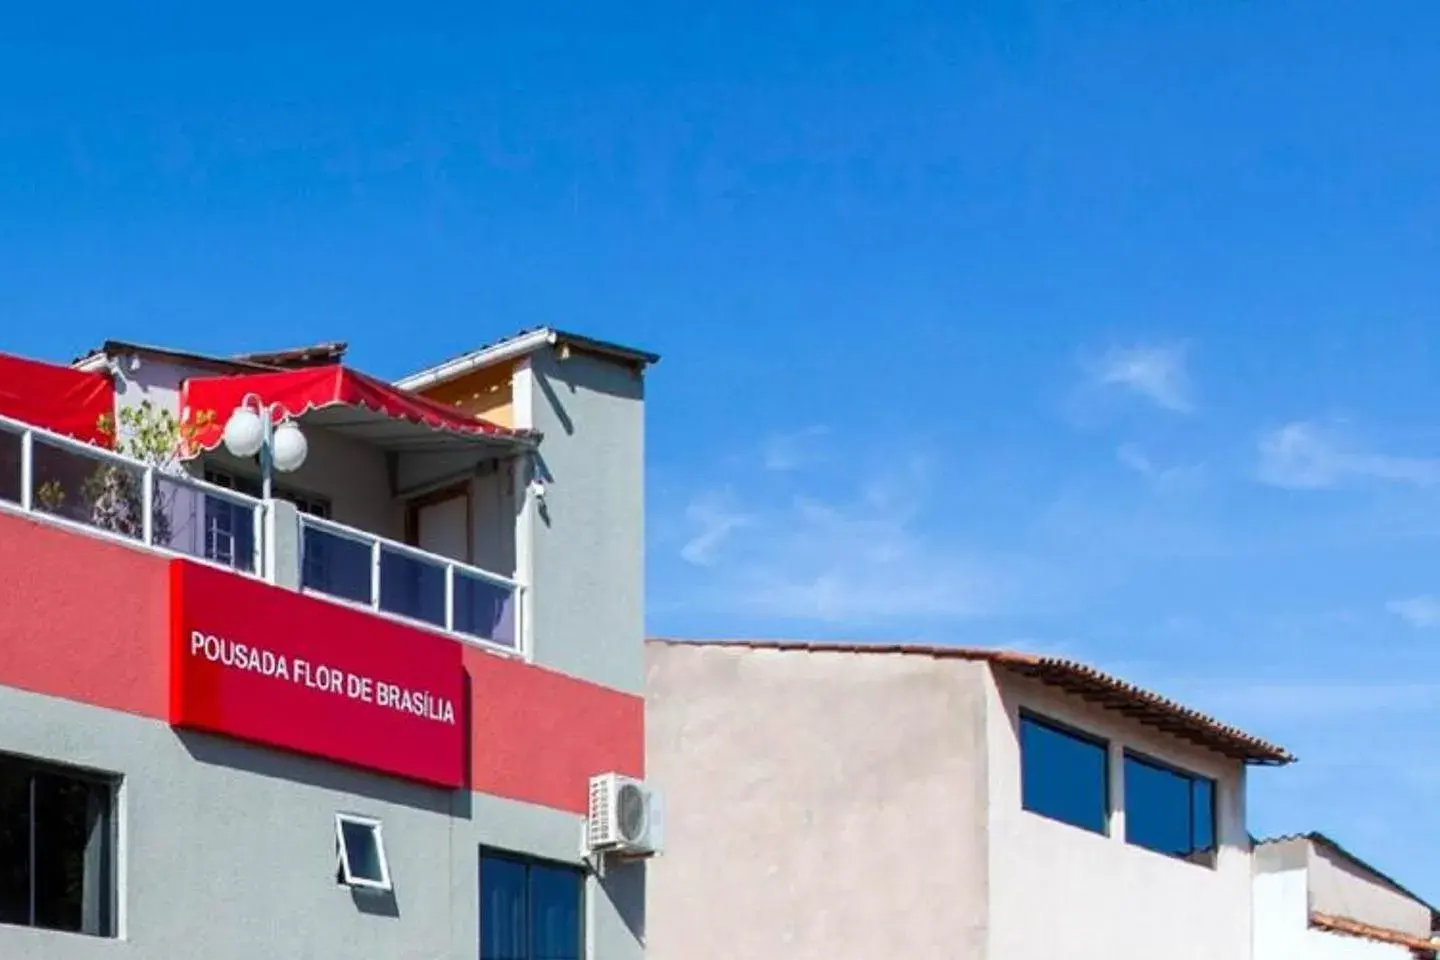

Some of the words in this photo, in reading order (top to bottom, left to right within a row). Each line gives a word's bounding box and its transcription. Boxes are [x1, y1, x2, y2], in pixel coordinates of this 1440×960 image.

[191, 631, 289, 681] POUSADA
[293, 658, 344, 695] FLOR
[347, 673, 372, 703] DE
[376, 682, 455, 724] BRASÍLIA
